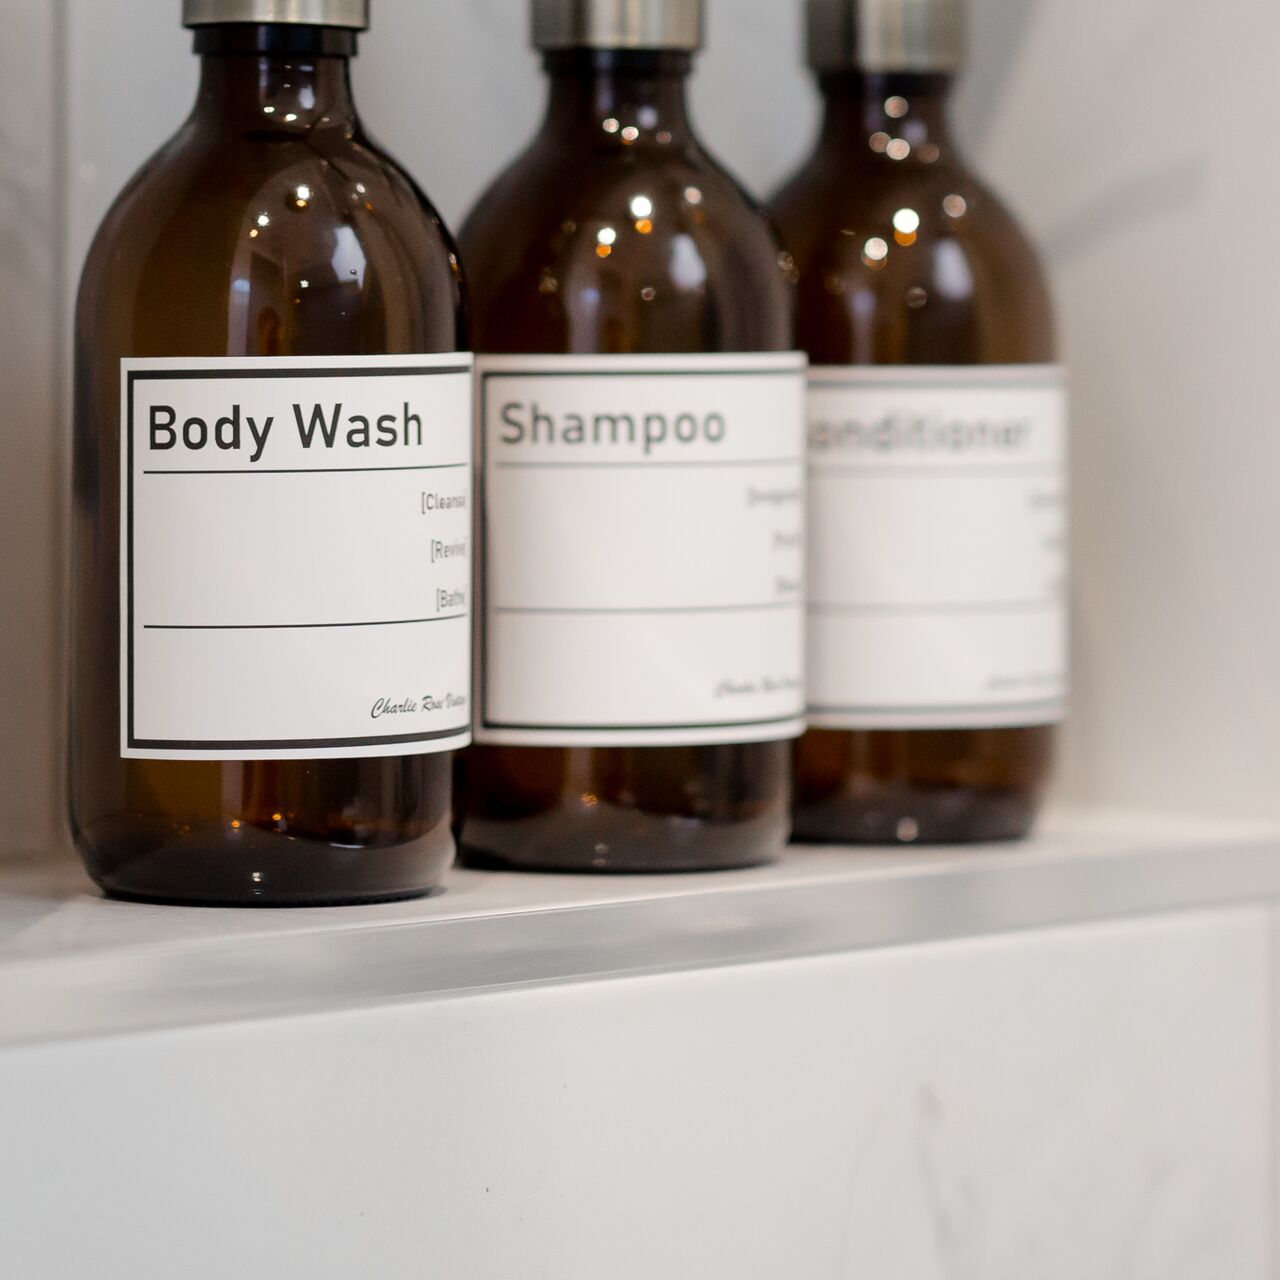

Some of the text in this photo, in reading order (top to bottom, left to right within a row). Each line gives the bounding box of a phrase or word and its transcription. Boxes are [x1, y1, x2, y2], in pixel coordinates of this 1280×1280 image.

[149, 401, 423, 463] Body Wash
[499, 401, 726, 456] Shampoo
[806, 407, 1033, 453] onditioner
[371, 697, 417, 719] Charlie
